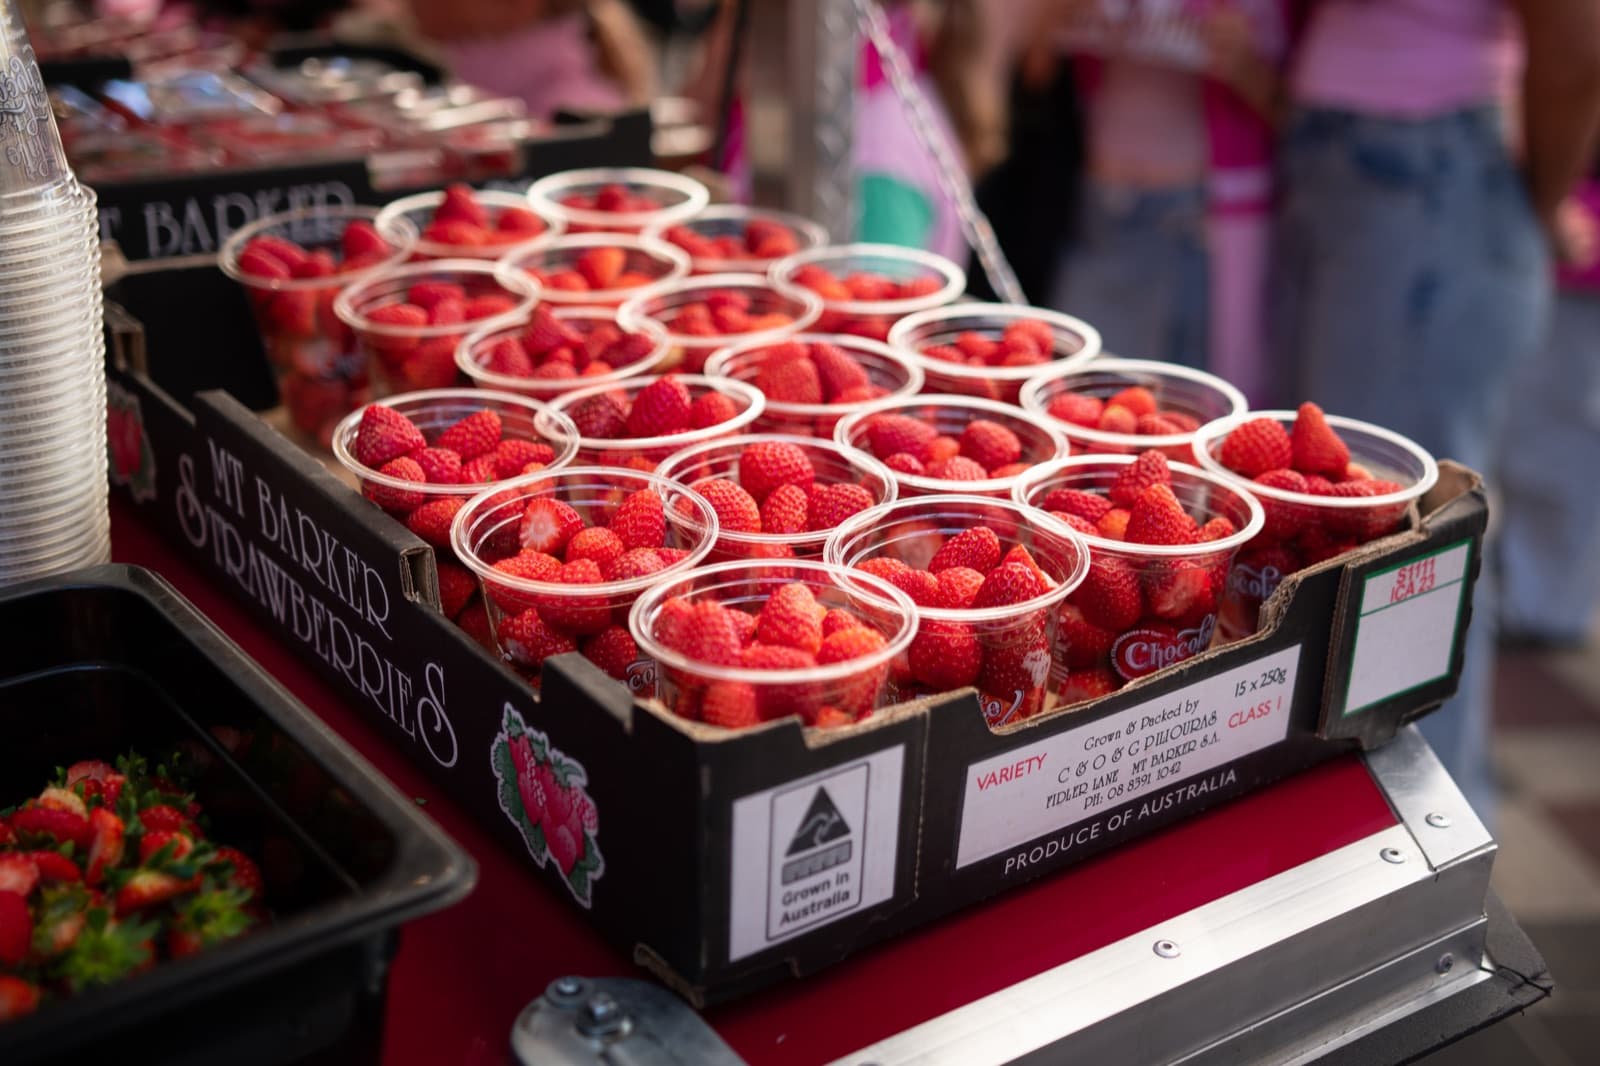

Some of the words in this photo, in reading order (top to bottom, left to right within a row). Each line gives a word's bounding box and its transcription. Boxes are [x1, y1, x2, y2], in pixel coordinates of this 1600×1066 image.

[208, 437, 245, 518] MT
[255, 476, 393, 641] BARKER
[176, 453, 458, 768] STRAWBERRIES
[1234, 680, 1247, 698] 15
[1259, 667, 1288, 689] 250g
[1141, 708, 1181, 730] Packed
[1184, 699, 1200, 714] by
[1228, 700, 1272, 729] CLASS
[976, 752, 1047, 792] VARIETY
[1046, 782, 1088, 809] FIDLER
[1092, 769, 1119, 791] LANE
[1131, 755, 1149, 776] MT
[1150, 739, 1197, 769] BARKER
[1107, 785, 1124, 801] 08
[1127, 774, 1152, 794] 8391
[1156, 761, 1182, 781] 1042
[1004, 822, 1101, 875] PRODUCE
[1107, 809, 1133, 831] OF
[1137, 768, 1237, 821] AUSTRALIA
[779, 889, 850, 927] Australia
[782, 879, 831, 907] Grown
[835, 871, 850, 886] in
